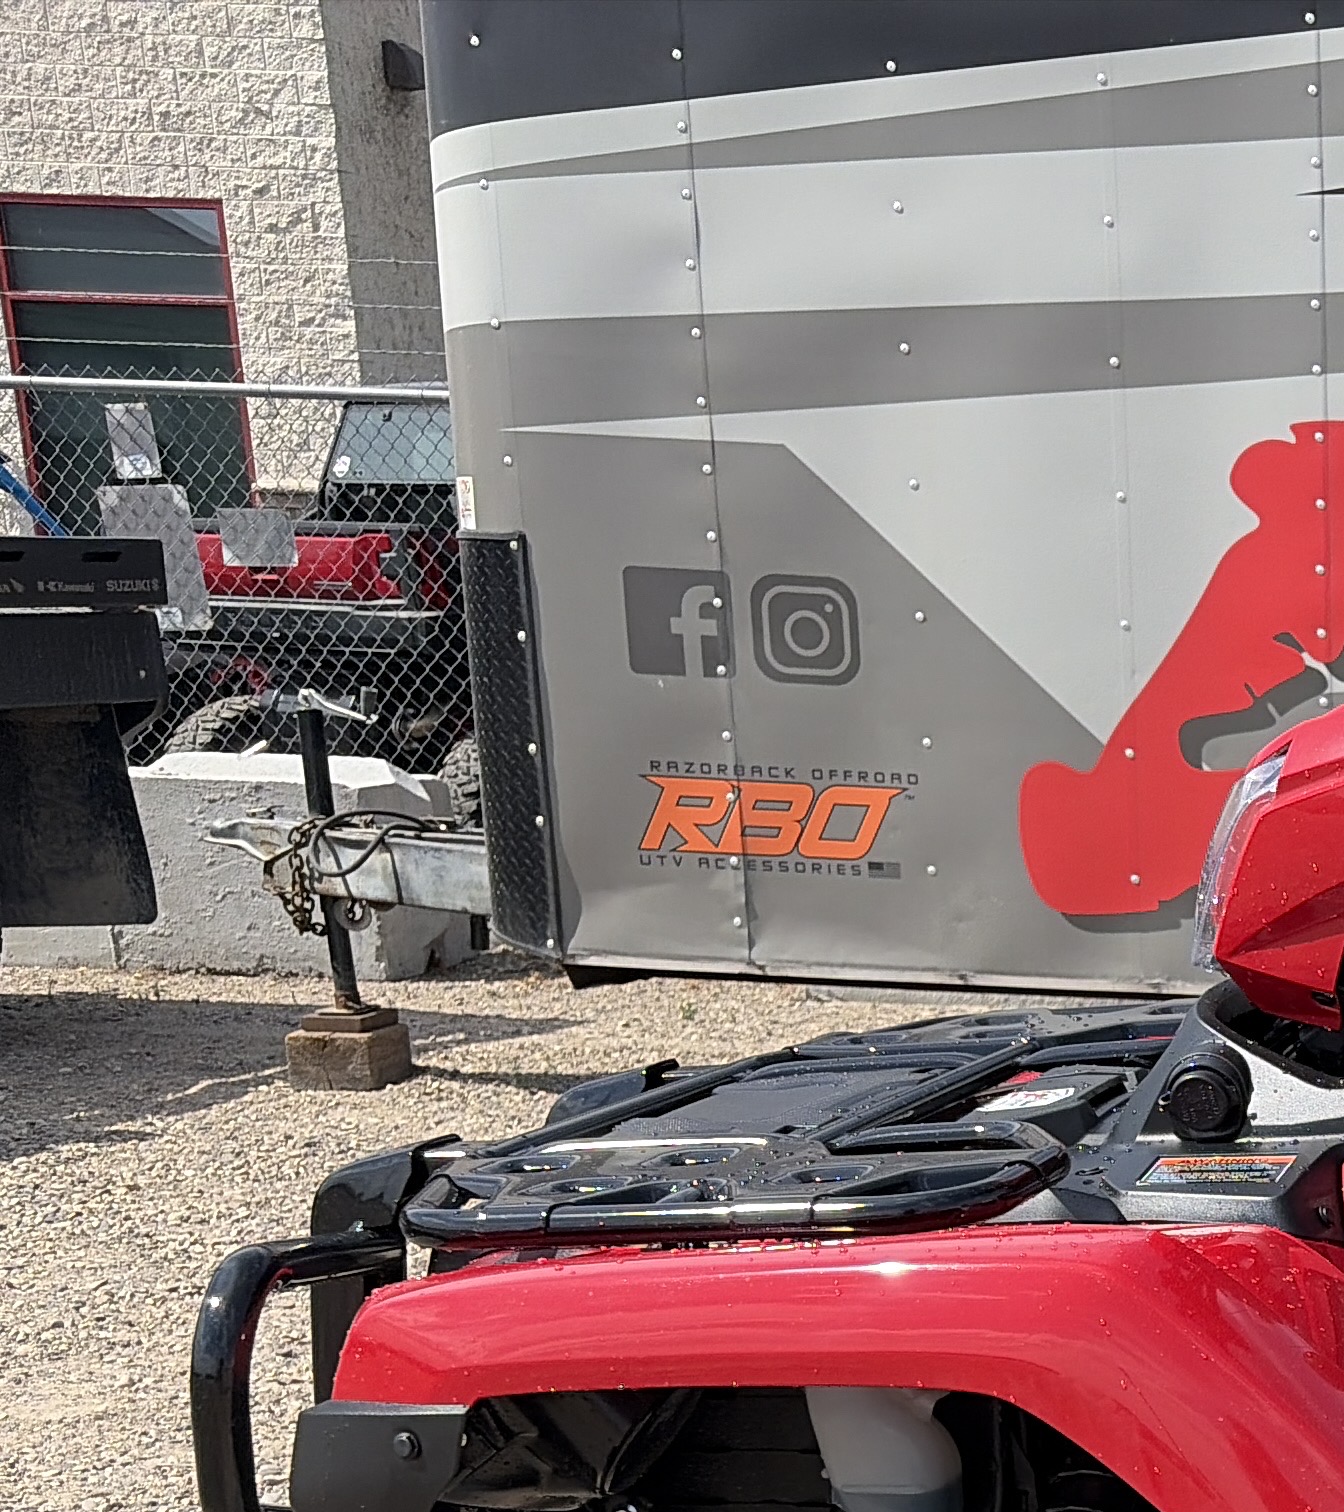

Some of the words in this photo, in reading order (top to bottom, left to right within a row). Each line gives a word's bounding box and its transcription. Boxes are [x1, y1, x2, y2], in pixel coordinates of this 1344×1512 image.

[649, 760, 796, 779] RAZORBACK
[811, 768, 919, 785] OFFROAD
[638, 774, 909, 861] RBO
[639, 854, 683, 867] UTV
[698, 856, 862, 877] ACCESSORIES
